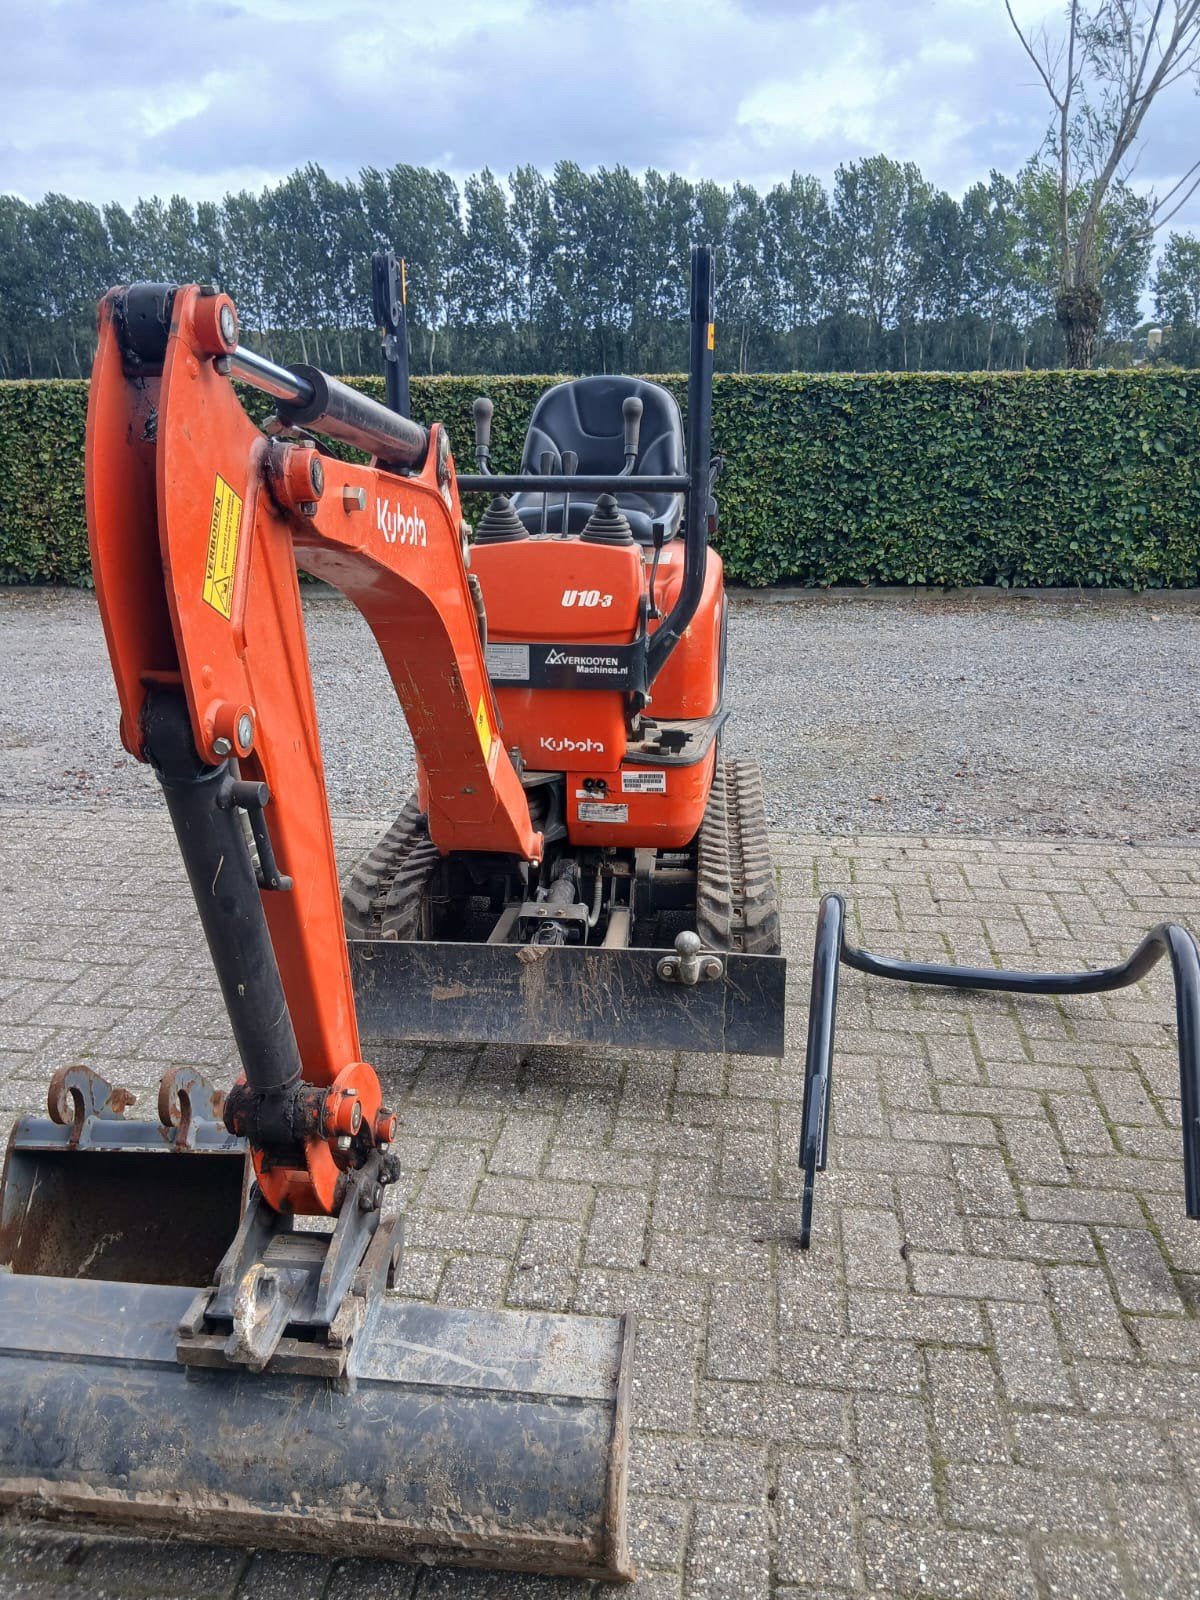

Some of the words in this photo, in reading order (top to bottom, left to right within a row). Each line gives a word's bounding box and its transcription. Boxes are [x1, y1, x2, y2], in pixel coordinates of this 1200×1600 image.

[376, 497, 427, 548] Kubota
[206, 496, 221, 580] VERBODEN
[561, 590, 613, 608] U10-3
[561, 656, 618, 666] VERKOOYEN
[576, 665, 628, 675] Machines.nl
[540, 737, 604, 752] Kubota
